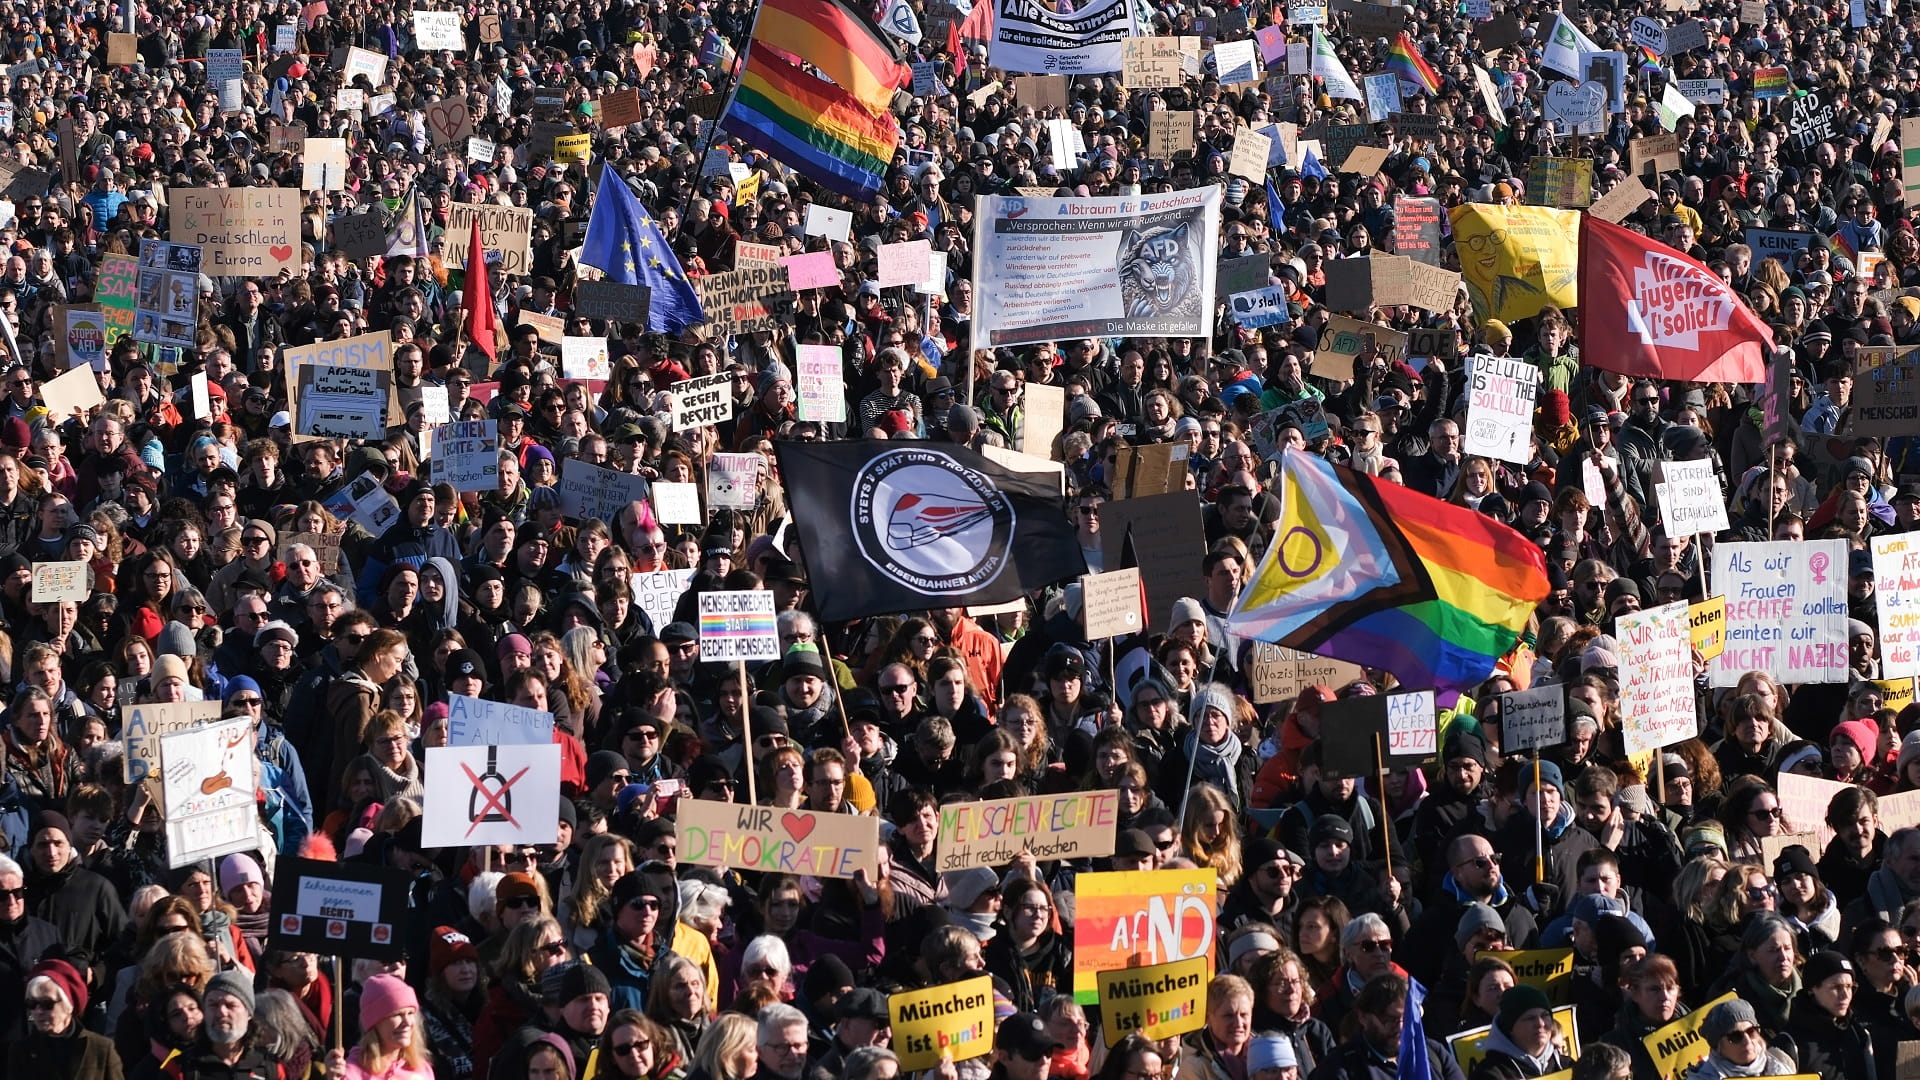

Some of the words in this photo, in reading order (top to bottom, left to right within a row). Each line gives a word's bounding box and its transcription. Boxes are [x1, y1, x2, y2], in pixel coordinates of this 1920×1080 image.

[1004, 1, 1039, 20] Alle
[1040, 2, 1126, 31] zusammen
[1015, 33, 1030, 42] eine
[1632, 20, 1663, 42] STOP!
[1792, 93, 1820, 118] AfD
[1790, 104, 1834, 135] Scheiß
[1327, 126, 1369, 139] HISTORY
[184, 194, 210, 210] Für
[1058, 203, 1117, 216] Albtraum
[1119, 201, 1137, 214] für
[1140, 192, 1203, 213] Deutschland
[274, 214, 284, 227] in
[1078, 219, 1105, 232] Wenn
[1108, 217, 1121, 229] wir
[1123, 217, 1137, 227] am
[1139, 213, 1162, 226] Ruder
[196, 232, 288, 246] Deutschland
[1758, 236, 1802, 250] KEINE
[214, 250, 263, 269] Europa
[737, 258, 764, 270] MACHT
[739, 245, 776, 262] KEINE
[623, 285, 647, 300] SIND
[702, 272, 741, 294] WENN
[703, 286, 764, 310] ANTWORT
[1640, 280, 1727, 319] jugend
[581, 300, 641, 319] SCHEISSE
[704, 307, 733, 325] WIE
[70, 328, 101, 341] STOPPT
[712, 320, 737, 337] DIE
[1107, 322, 1124, 332] Die
[1126, 321, 1157, 332] Maske
[1158, 321, 1169, 332] ist
[1169, 321, 1199, 333] gefallen
[78, 340, 96, 353] AFD
[1410, 332, 1451, 357] LOVE
[799, 362, 842, 375] RECHTE
[1475, 355, 1536, 383] DELULU
[681, 390, 720, 408] GEGEN
[1471, 374, 1487, 391] IS
[1489, 376, 1516, 397] NOT
[1514, 380, 1536, 402] THE
[680, 402, 728, 426] RECHTS
[1472, 390, 1527, 417] SOLULU
[1859, 406, 1919, 421] MENSCHEN
[437, 420, 487, 443] MENSCHEN
[447, 470, 483, 484] Menschen
[1671, 466, 1713, 483] EXTREME
[859, 483, 876, 525] STETS
[906, 453, 936, 462] UND
[992, 498, 1005, 512] DA
[1682, 485, 1704, 498] SIND
[886, 562, 968, 590] EISENBAHNER
[969, 555, 1000, 586] ANTIFA
[1728, 551, 1753, 574] Als
[1764, 552, 1793, 569] wir
[640, 571, 678, 593] KEIN
[1740, 581, 1797, 600] Frauen
[1877, 579, 1900, 594] die
[643, 590, 682, 612] BIER
[700, 594, 773, 613] MENSCHENRECHTE
[1725, 597, 1794, 622] RECHTE
[1887, 595, 1902, 607] ist
[725, 617, 753, 631] STATT
[1628, 624, 1653, 646] WIR
[1657, 619, 1680, 641] alle
[1790, 622, 1817, 641] wir
[701, 638, 733, 658] RECHTE
[734, 634, 778, 657] MENSCHEN
[1882, 632, 1904, 645] war
[1628, 650, 1663, 667] warten
[1665, 638, 1683, 661] auf
[1720, 645, 1776, 672] NICHT
[1788, 640, 1851, 670] NAZIS
[1890, 648, 1912, 667] die
[1255, 662, 1294, 682] (Nazis
[1297, 660, 1337, 679] Hassen
[1260, 683, 1293, 698] Diesen
[1631, 689, 1651, 703] aber
[450, 695, 495, 720] AUF
[503, 706, 551, 730] KEINEN
[1389, 693, 1424, 717] AfD
[1631, 703, 1651, 718] bitte
[1653, 703, 1668, 714] den
[1669, 696, 1695, 714] MERZ
[126, 737, 157, 761] Fall
[1390, 729, 1437, 749] JETZT
[736, 806, 774, 833] WIR
[940, 794, 1116, 844] MENSCHENRECHTE
[685, 826, 863, 877] DEMOKRATIE
[941, 844, 973, 870] statt
[975, 839, 1020, 865] rechte
[1021, 835, 1078, 858] Menschen
[319, 906, 355, 920] RECHTS
[1109, 973, 1201, 1001] München
[898, 992, 986, 1023] München
[1116, 1011, 1144, 1031] ist
[1146, 998, 1197, 1028] bunt!
[905, 1032, 932, 1054] ist
[936, 1020, 984, 1051] bunt!
